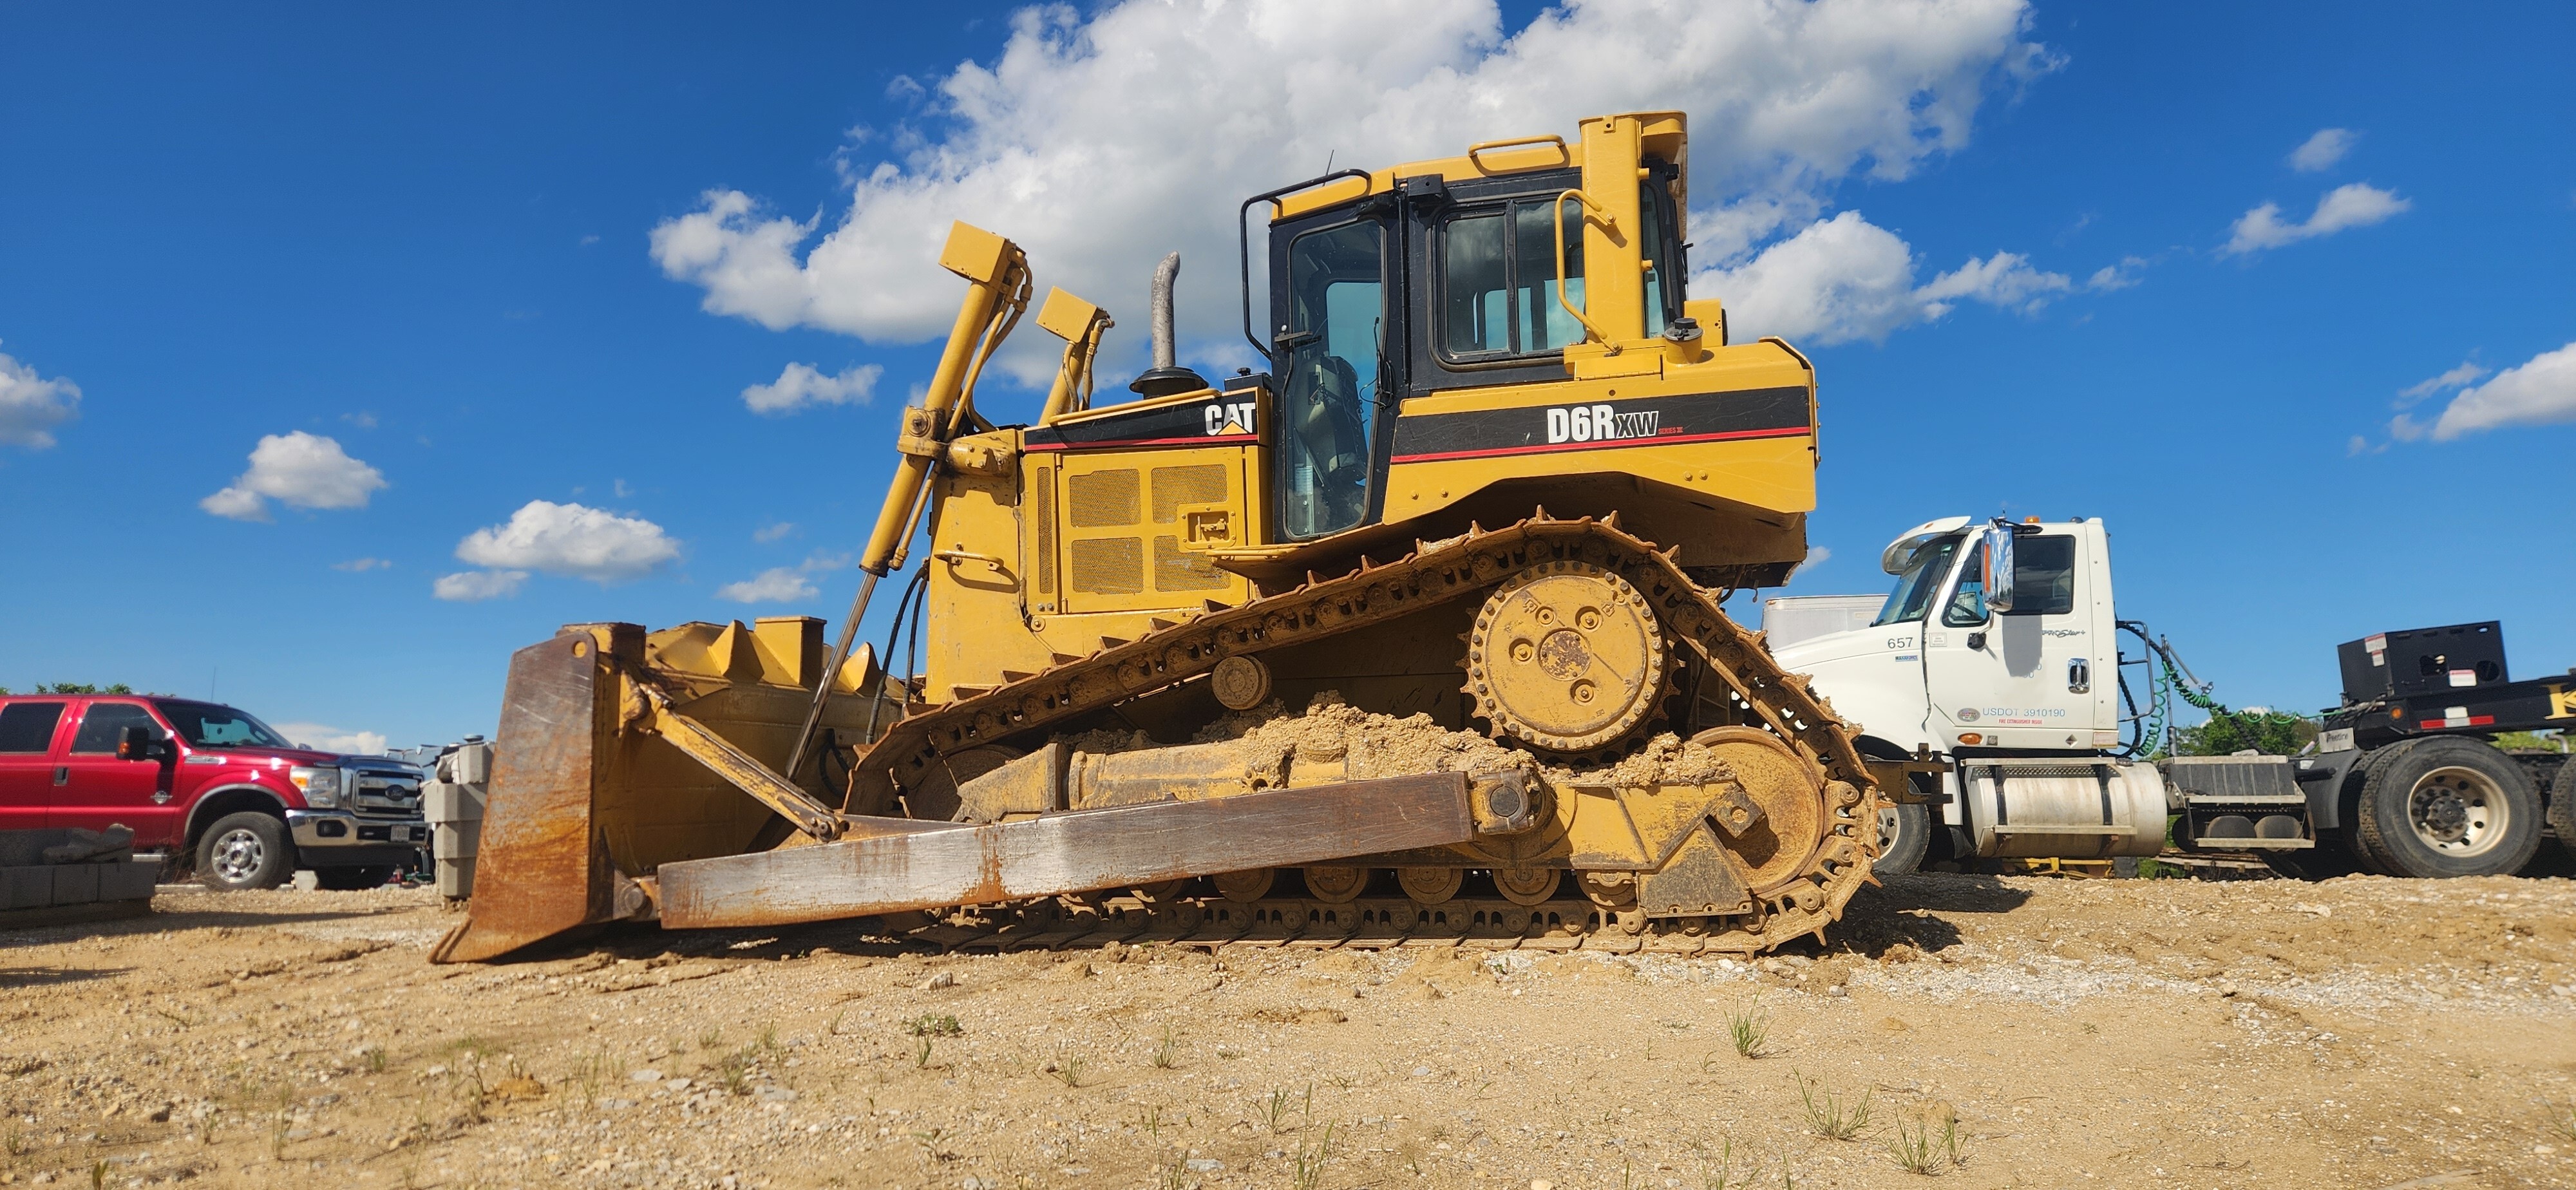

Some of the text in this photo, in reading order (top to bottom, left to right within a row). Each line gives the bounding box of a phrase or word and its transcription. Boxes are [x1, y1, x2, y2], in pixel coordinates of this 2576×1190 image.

[1205, 402, 1256, 436] CAT
[1888, 637, 1913, 649] 657
[1983, 708, 2018, 716] USDOT
[2023, 708, 2065, 717] 3910190
